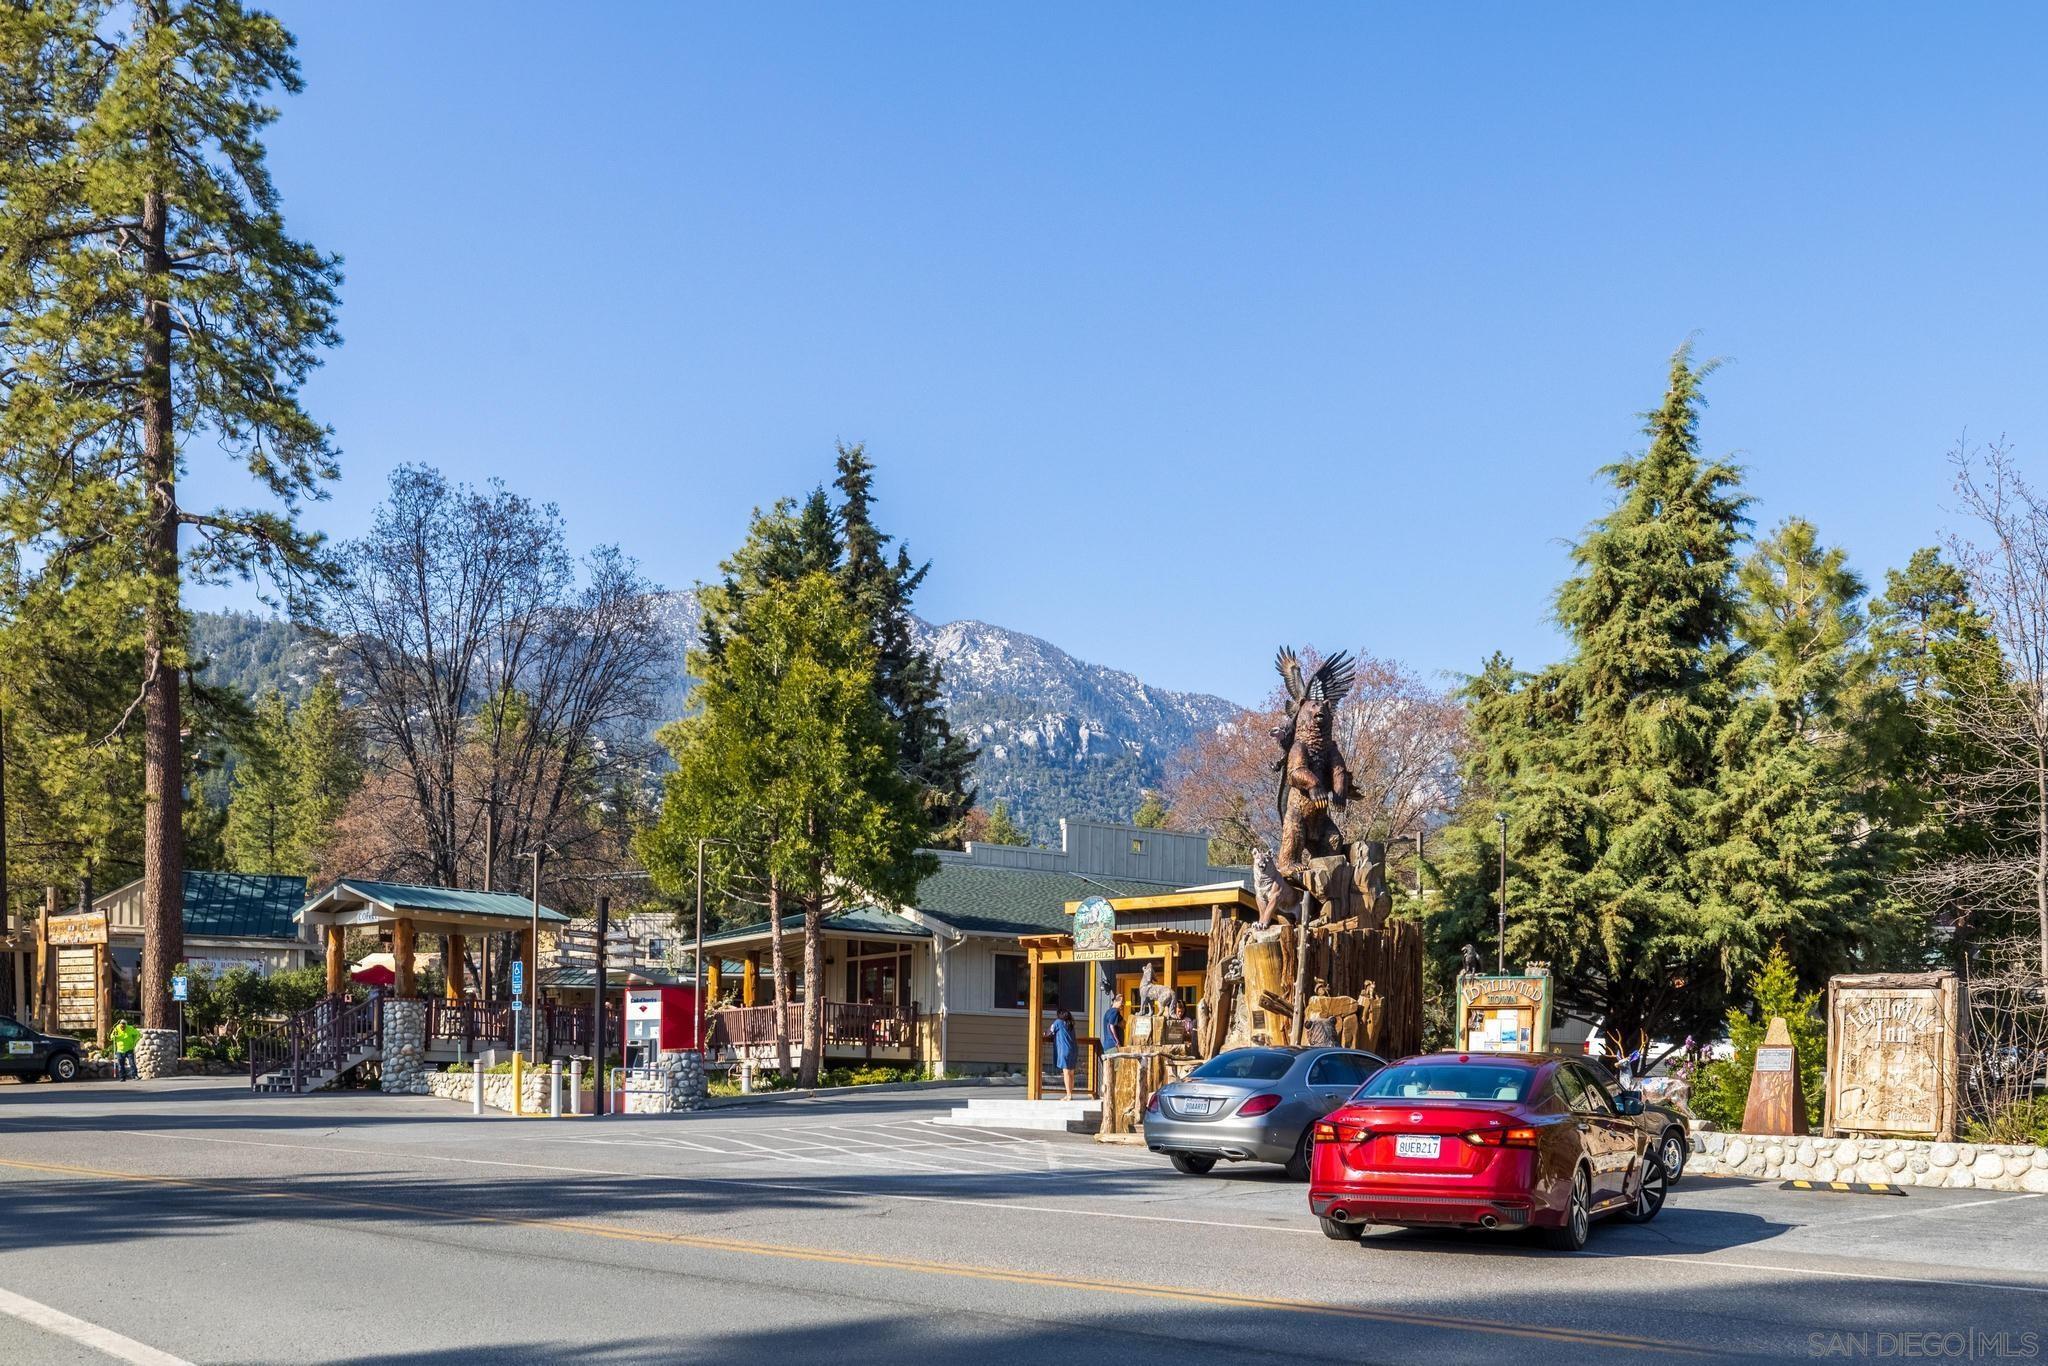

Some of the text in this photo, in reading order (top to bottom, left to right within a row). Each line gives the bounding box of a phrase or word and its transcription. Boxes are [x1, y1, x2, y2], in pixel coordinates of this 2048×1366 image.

[1075, 951, 1113, 960] WILD RIDES
[1461, 979, 1543, 1005] IDYLLWILD
[1846, 998, 1936, 1032] Idyllwild
[1875, 1020, 1908, 1043] Inn
[1399, 1141, 1439, 1154] 8UEB217
